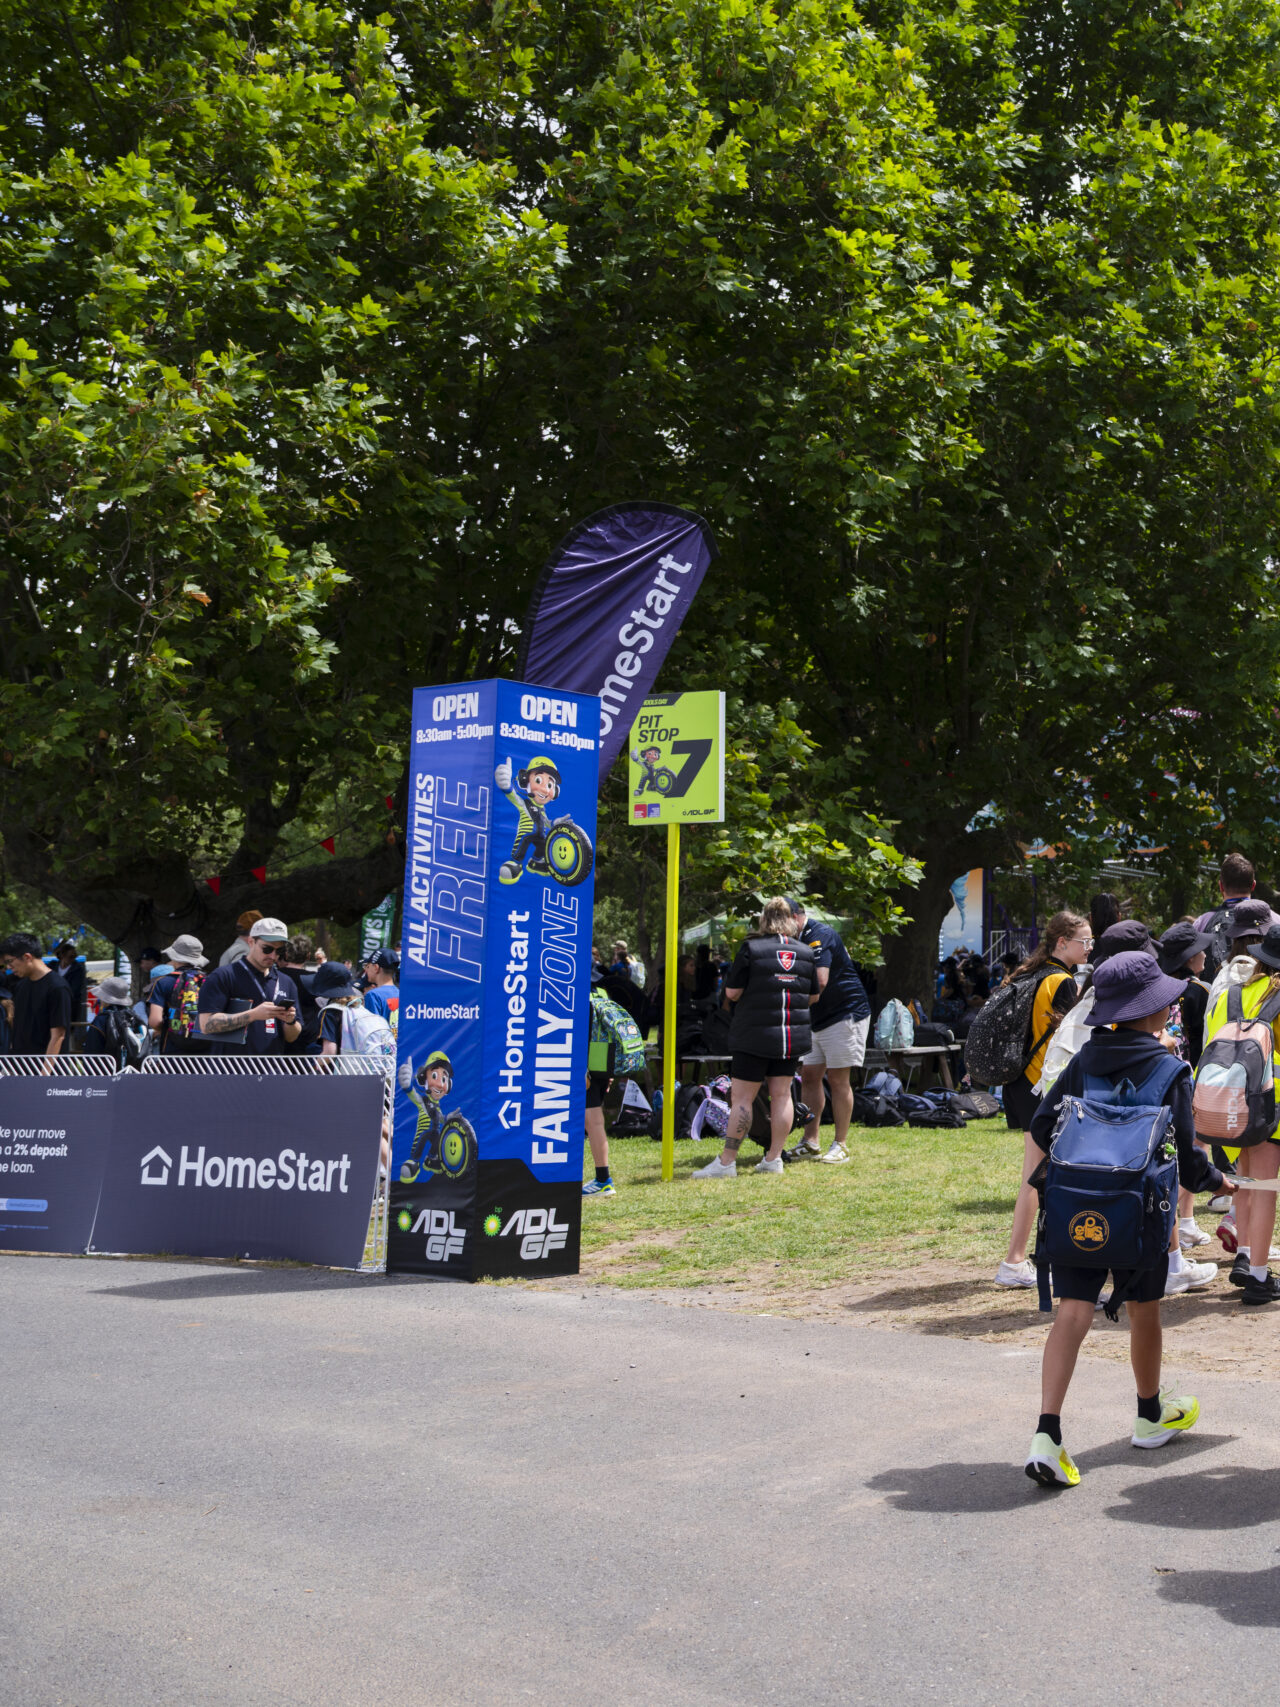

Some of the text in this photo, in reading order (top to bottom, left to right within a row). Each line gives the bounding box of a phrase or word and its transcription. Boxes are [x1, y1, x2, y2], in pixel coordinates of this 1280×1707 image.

[598, 553, 693, 749] omeStart
[432, 692, 479, 721] OPEN
[520, 694, 578, 727] OPEN
[638, 715, 664, 728] PIT
[638, 728, 679, 743] STOP
[664, 739, 713, 798] 7
[408, 772, 435, 966] ALL ACTIVITIES
[427, 776, 489, 984] FREE
[417, 1004, 480, 1020] HomeStart
[498, 910, 530, 1093] HomeStart
[52, 1088, 83, 1096] HomeStart
[531, 1008, 575, 1165] FAMILY
[13, 1129, 36, 1142] your
[38, 1129, 66, 1140] move
[4, 1145, 12, 1155] a
[13, 1144, 29, 1156] 2%
[30, 1144, 69, 1160] deposit
[11, 1161, 35, 1173] loan.
[178, 1145, 351, 1193] HomeStart
[410, 1209, 467, 1237] ADL
[500, 1208, 569, 1237] ADL
[425, 1235, 465, 1262] GF
[519, 1232, 568, 1260] GF
